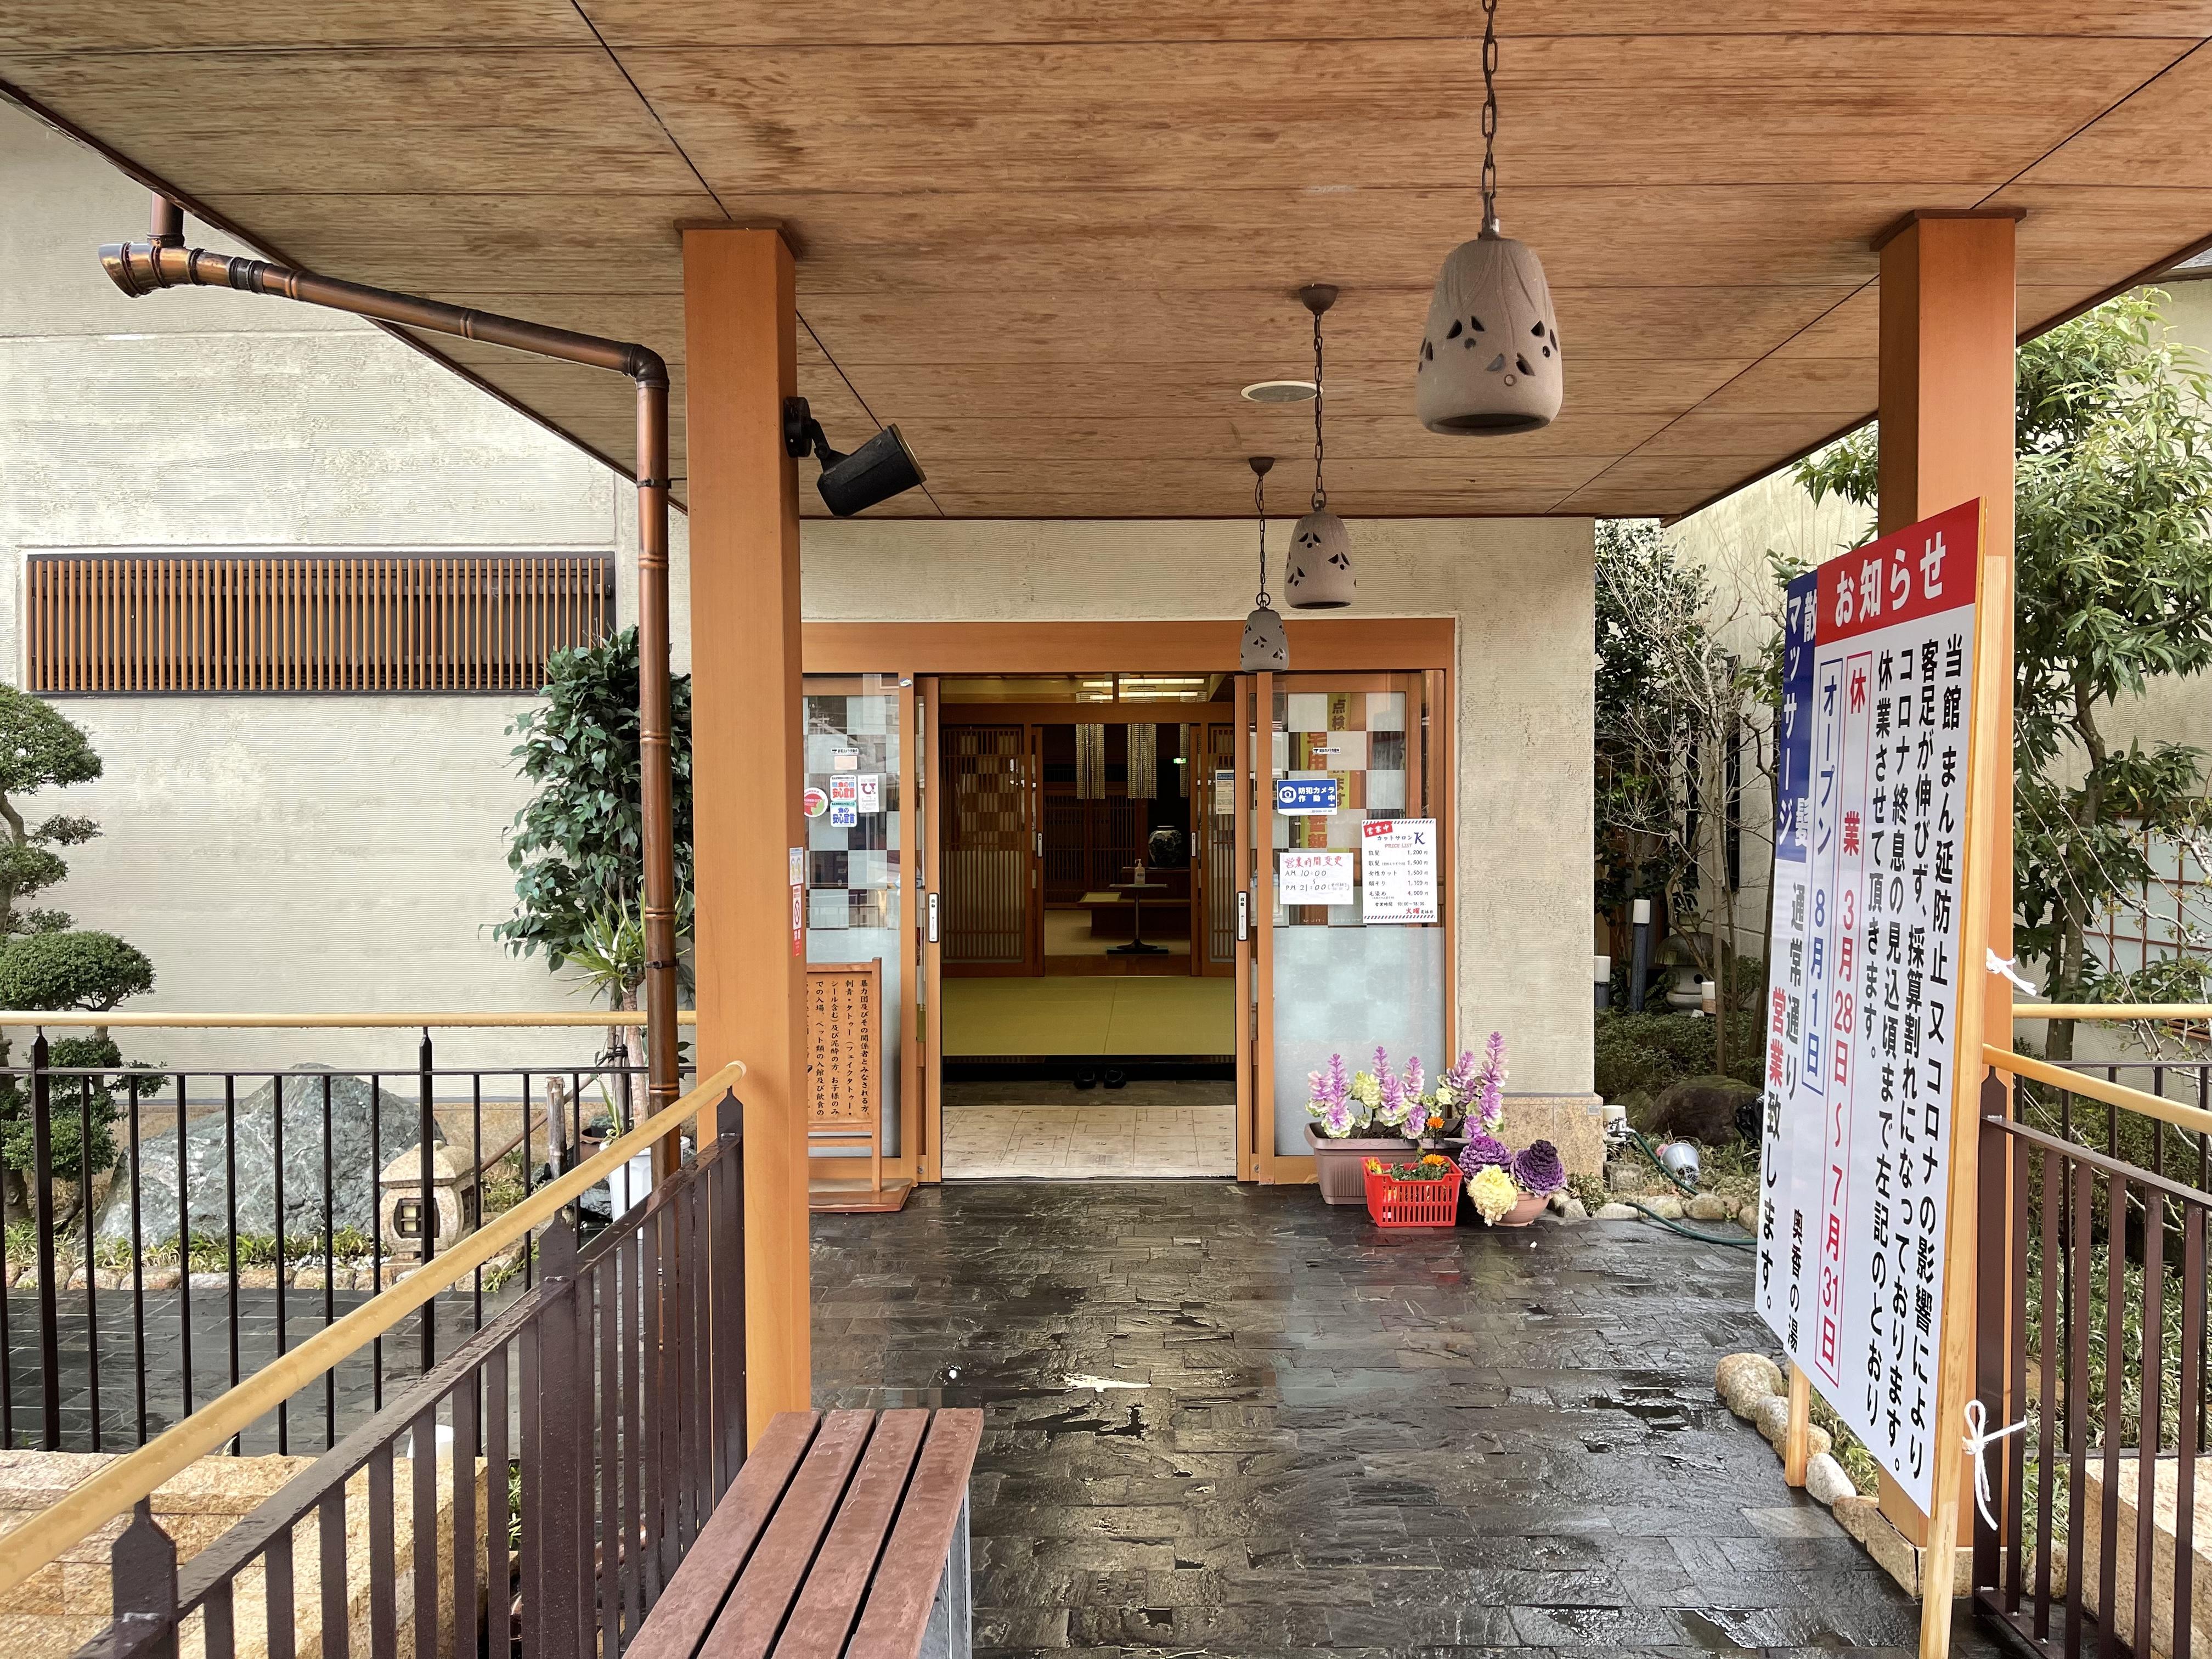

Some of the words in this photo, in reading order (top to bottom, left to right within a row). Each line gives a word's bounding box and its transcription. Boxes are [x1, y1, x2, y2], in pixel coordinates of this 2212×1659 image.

[1836, 530, 1946, 627] お知らせ
[1298, 786, 1335, 794] 防犯カメラ
[1779, 596, 1803, 845] マッサージ
[1818, 675, 1838, 856] オープン
[832, 814, 855, 824] 安心宣言
[1414, 832, 1425, 845] K
[1863, 651, 1893, 1058] 休業させて頂きます。
[1786, 882, 1805, 1101] 通常通り
[1866, 650, 1913, 1427] コロナ終息の見込頃まで左記のとおり
[1763, 986, 1786, 1310] 営業致します。
[1787, 1208, 1804, 1353] 奥香の湯
